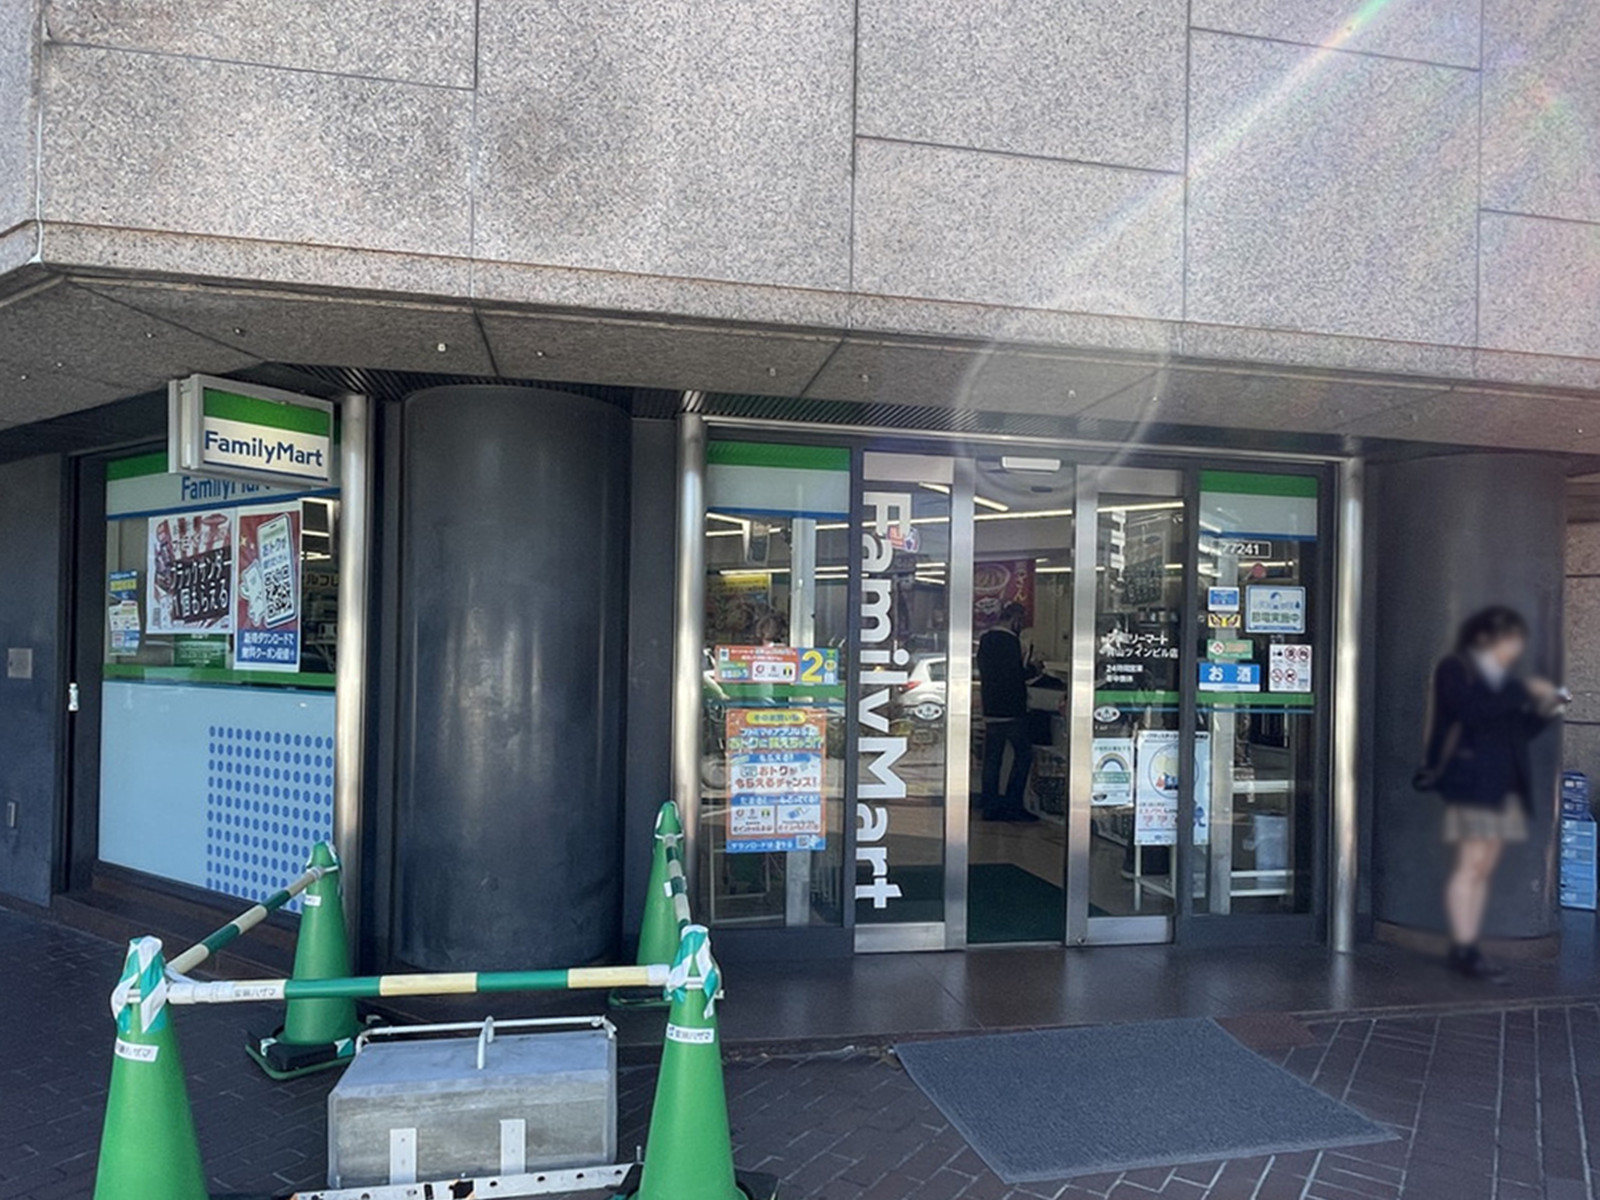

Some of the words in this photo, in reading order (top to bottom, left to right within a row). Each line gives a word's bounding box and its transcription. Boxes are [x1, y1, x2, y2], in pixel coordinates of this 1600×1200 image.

[204, 430, 323, 467] FamilyMart
[802, 650, 824, 683] 2
[1208, 665, 1252, 682] お酒
[855, 491, 912, 909] FamilyMart
